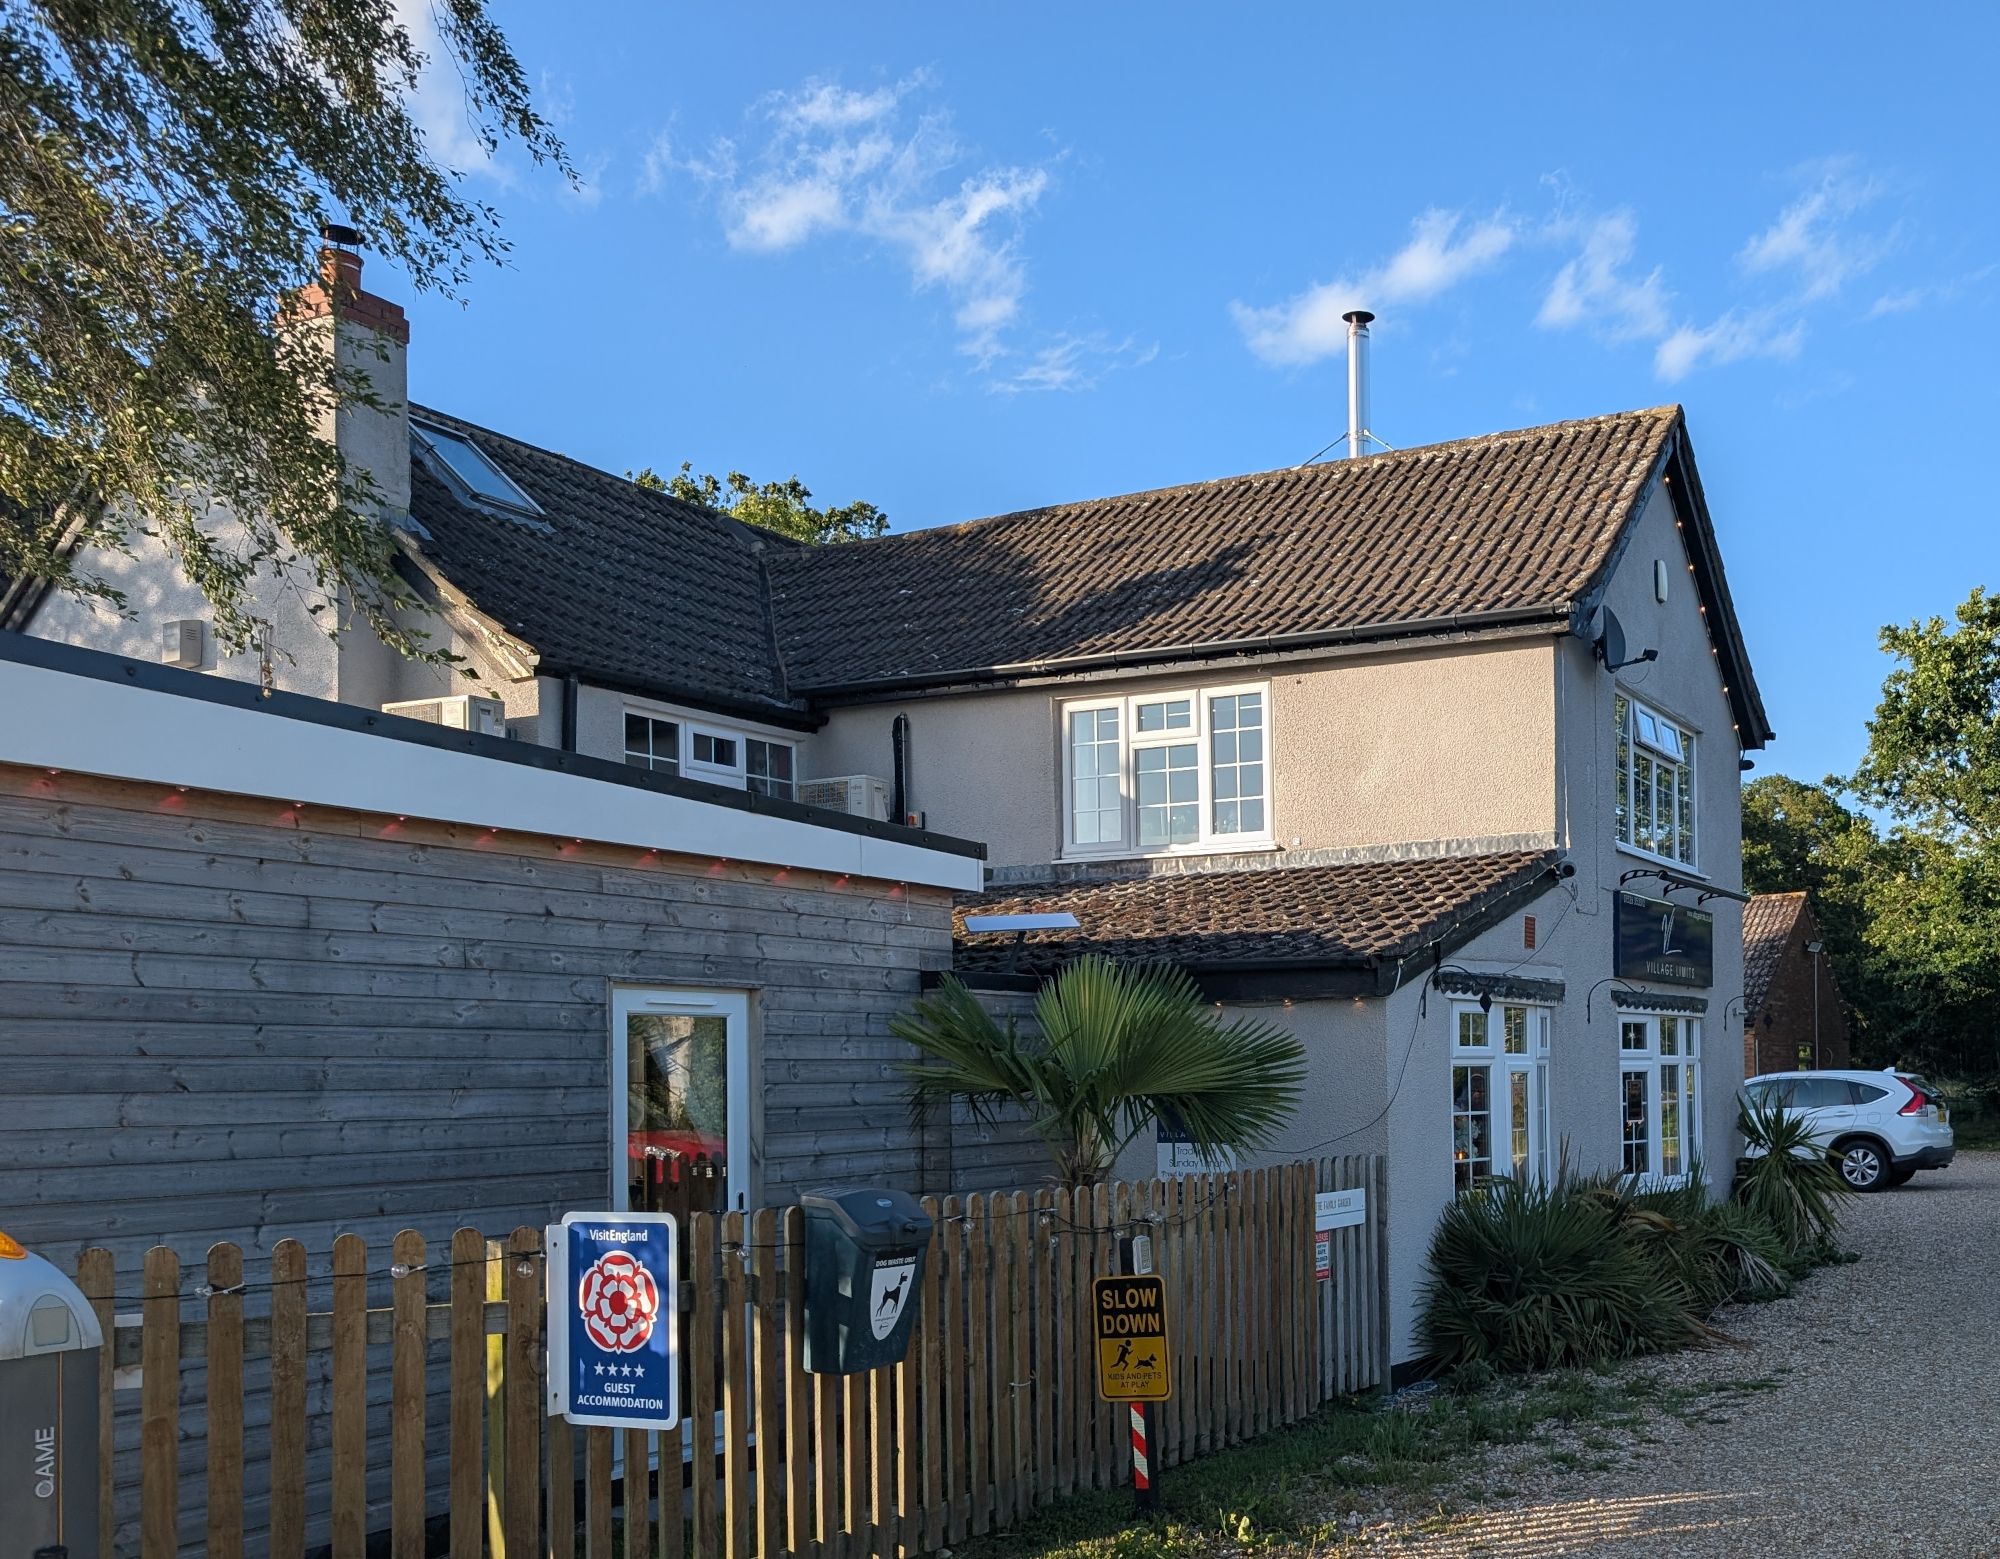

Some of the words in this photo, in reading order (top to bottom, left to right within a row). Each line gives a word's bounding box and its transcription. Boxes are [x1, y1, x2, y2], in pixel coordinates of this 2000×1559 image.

[1646, 961, 1673, 976] VILLAGE
[1675, 964, 1695, 980] LIMITS
[590, 1229, 648, 1243] VisitEngland
[888, 1257, 904, 1265] WASTE
[1102, 1288, 1157, 1309] SLOW
[1103, 1313, 1160, 1334] DOWN
[1107, 1373, 1125, 1381] KIDS
[1143, 1372, 1162, 1380] PETS
[604, 1382, 636, 1394] GUEST
[1131, 1381, 1150, 1389] PLAY
[577, 1394, 663, 1410] ACCOMMODATION
